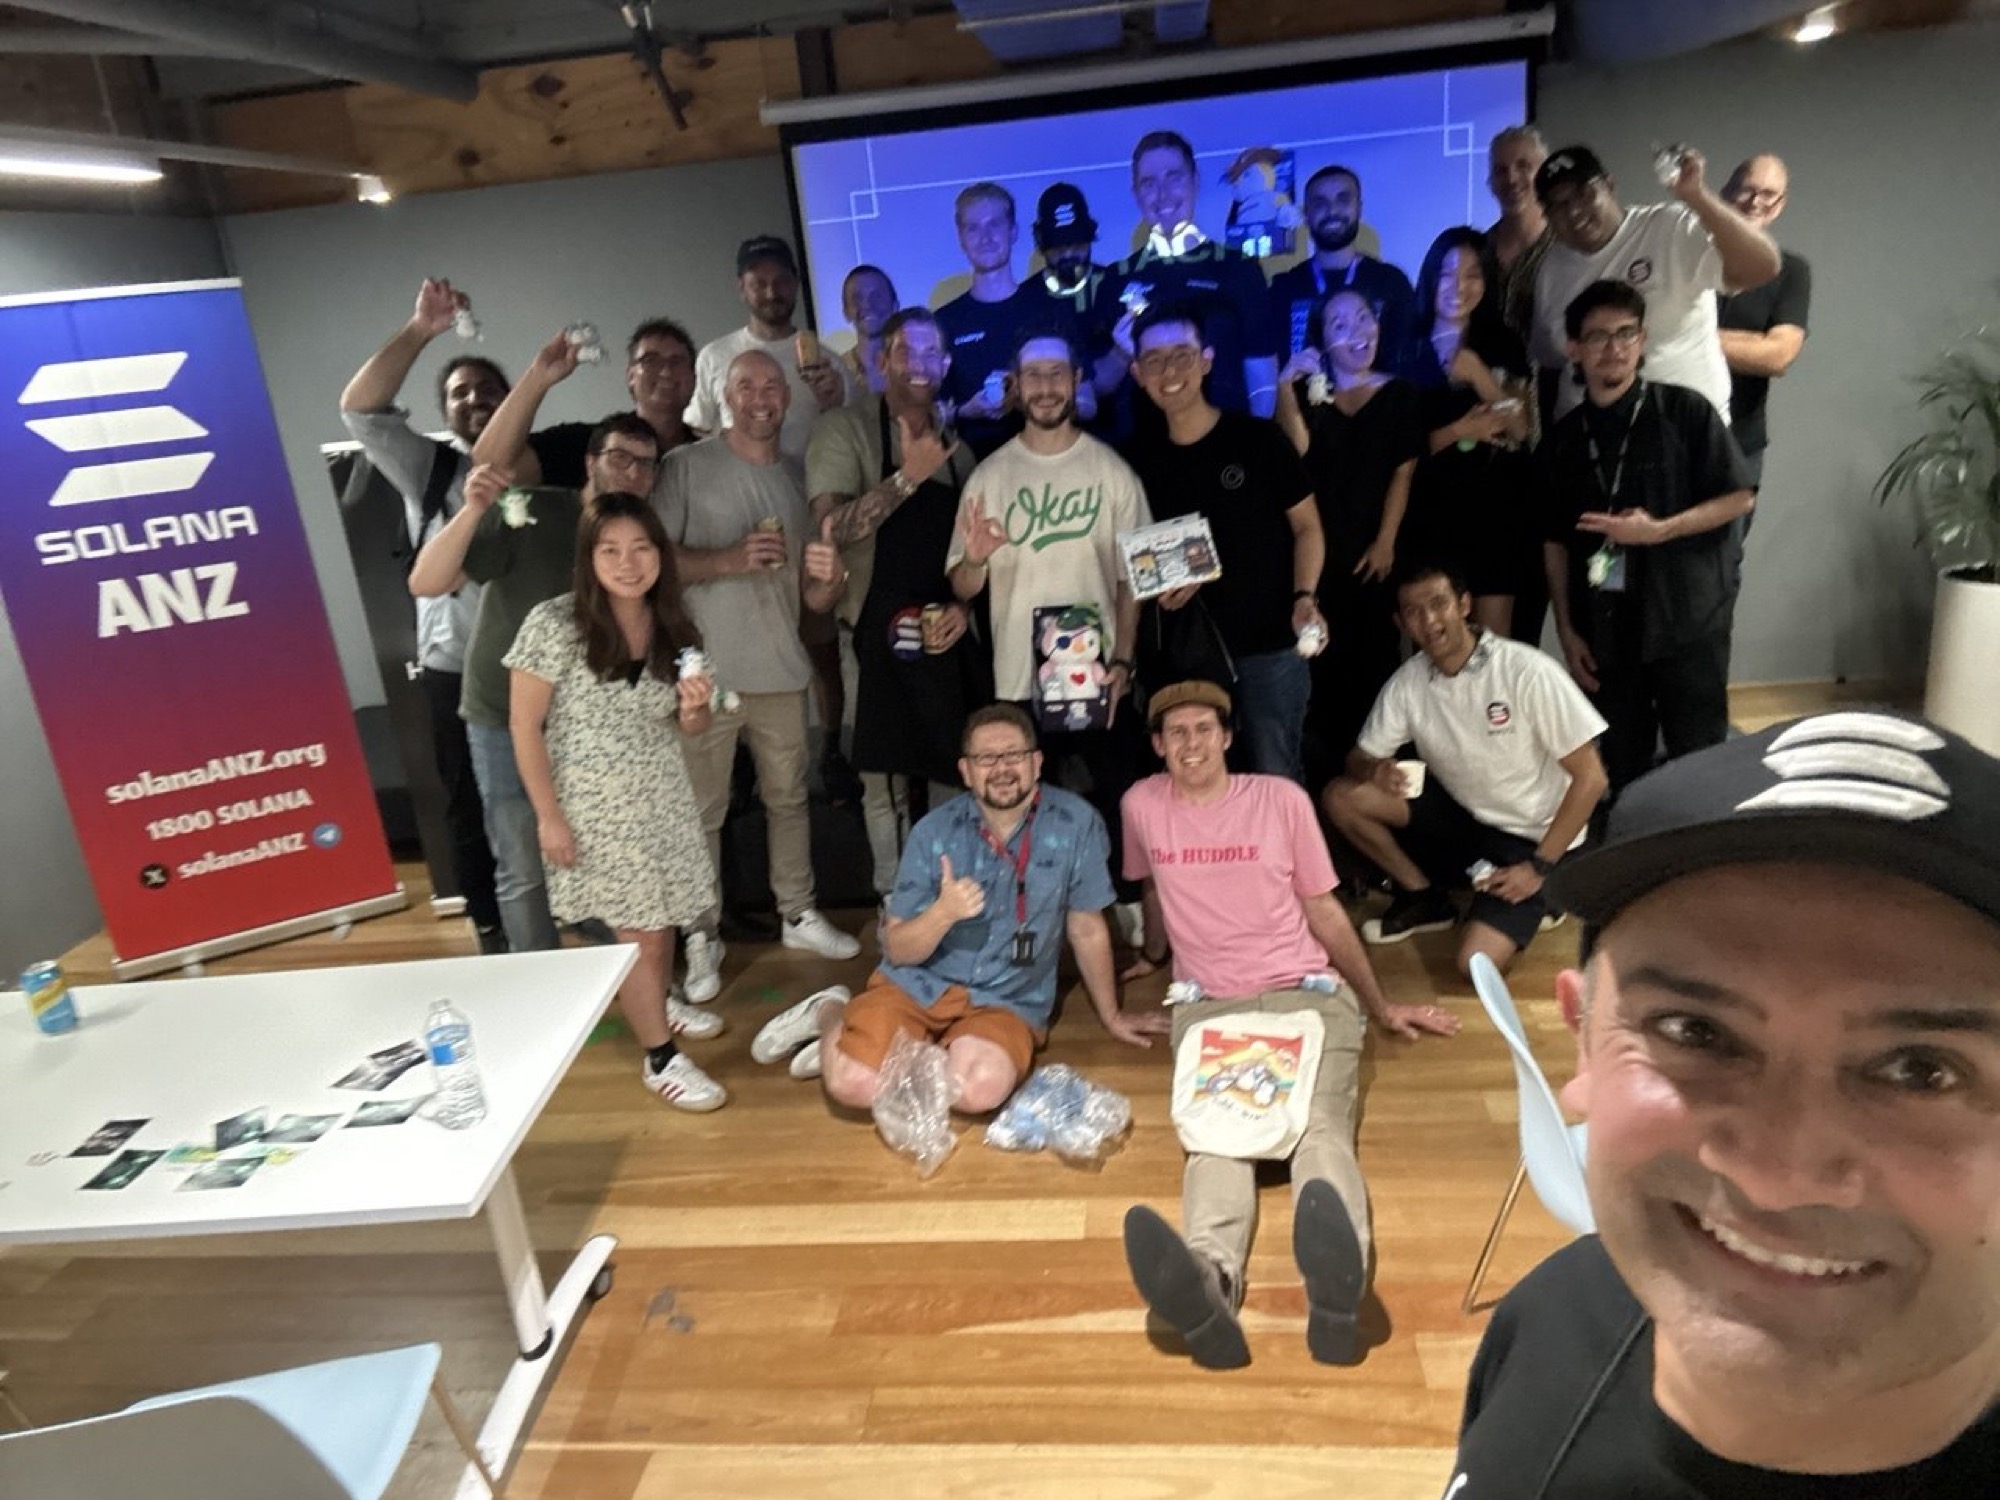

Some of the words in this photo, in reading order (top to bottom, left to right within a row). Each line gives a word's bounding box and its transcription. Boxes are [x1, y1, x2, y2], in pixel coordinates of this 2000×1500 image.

[34, 505, 259, 566] SOLANA
[1004, 481, 1103, 552] Okay
[97, 560, 251, 639] ANZ
[105, 742, 328, 805] solanaANZ.org
[145, 809, 214, 841] 1800
[216, 788, 315, 825] SOLANA
[177, 832, 309, 879] solanaANZ
[1181, 844, 1261, 864] HUDDLE
